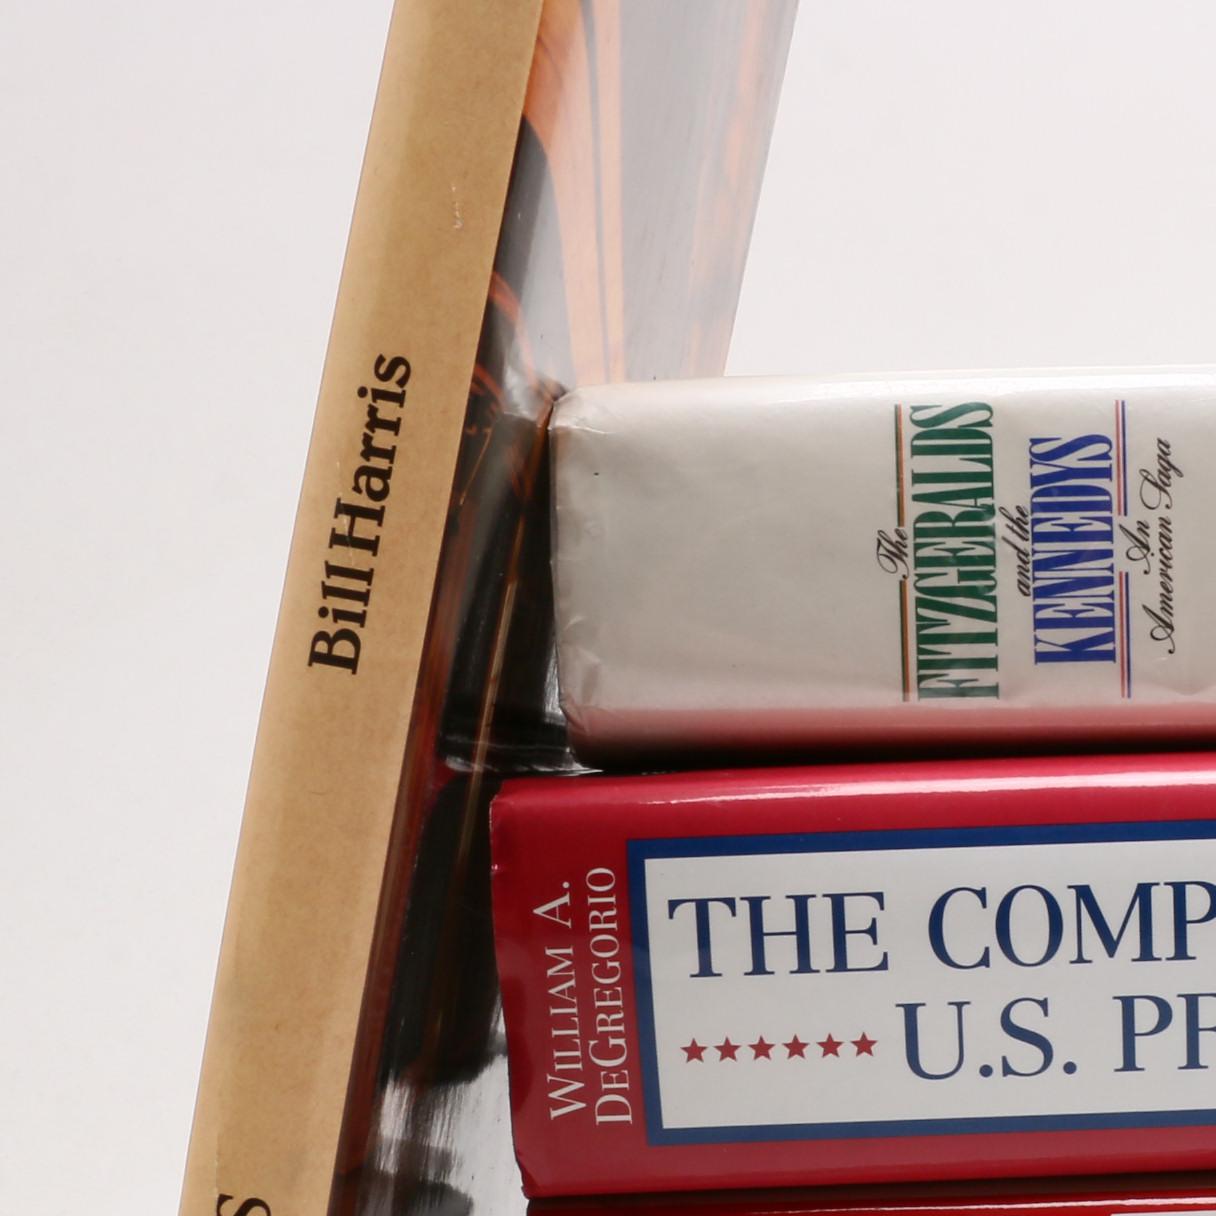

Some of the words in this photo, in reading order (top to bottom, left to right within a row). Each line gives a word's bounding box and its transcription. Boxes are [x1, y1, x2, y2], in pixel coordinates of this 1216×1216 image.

[329, 353, 411, 557] Harris
[1139, 437, 1184, 510] Saga
[876, 527, 909, 580] The
[910, 401, 1000, 701] FITZGERALDS
[998, 505, 1030, 542] the
[1001, 535, 1031, 597] and
[1029, 433, 1116, 665] KENNEDYS
[1118, 519, 1151, 576] An
[308, 558, 374, 675] Bill
[1142, 516, 1176, 655] American
[532, 880, 573, 930] A.
[667, 891, 889, 978] THE
[895, 996, 1078, 1081] U.S.
